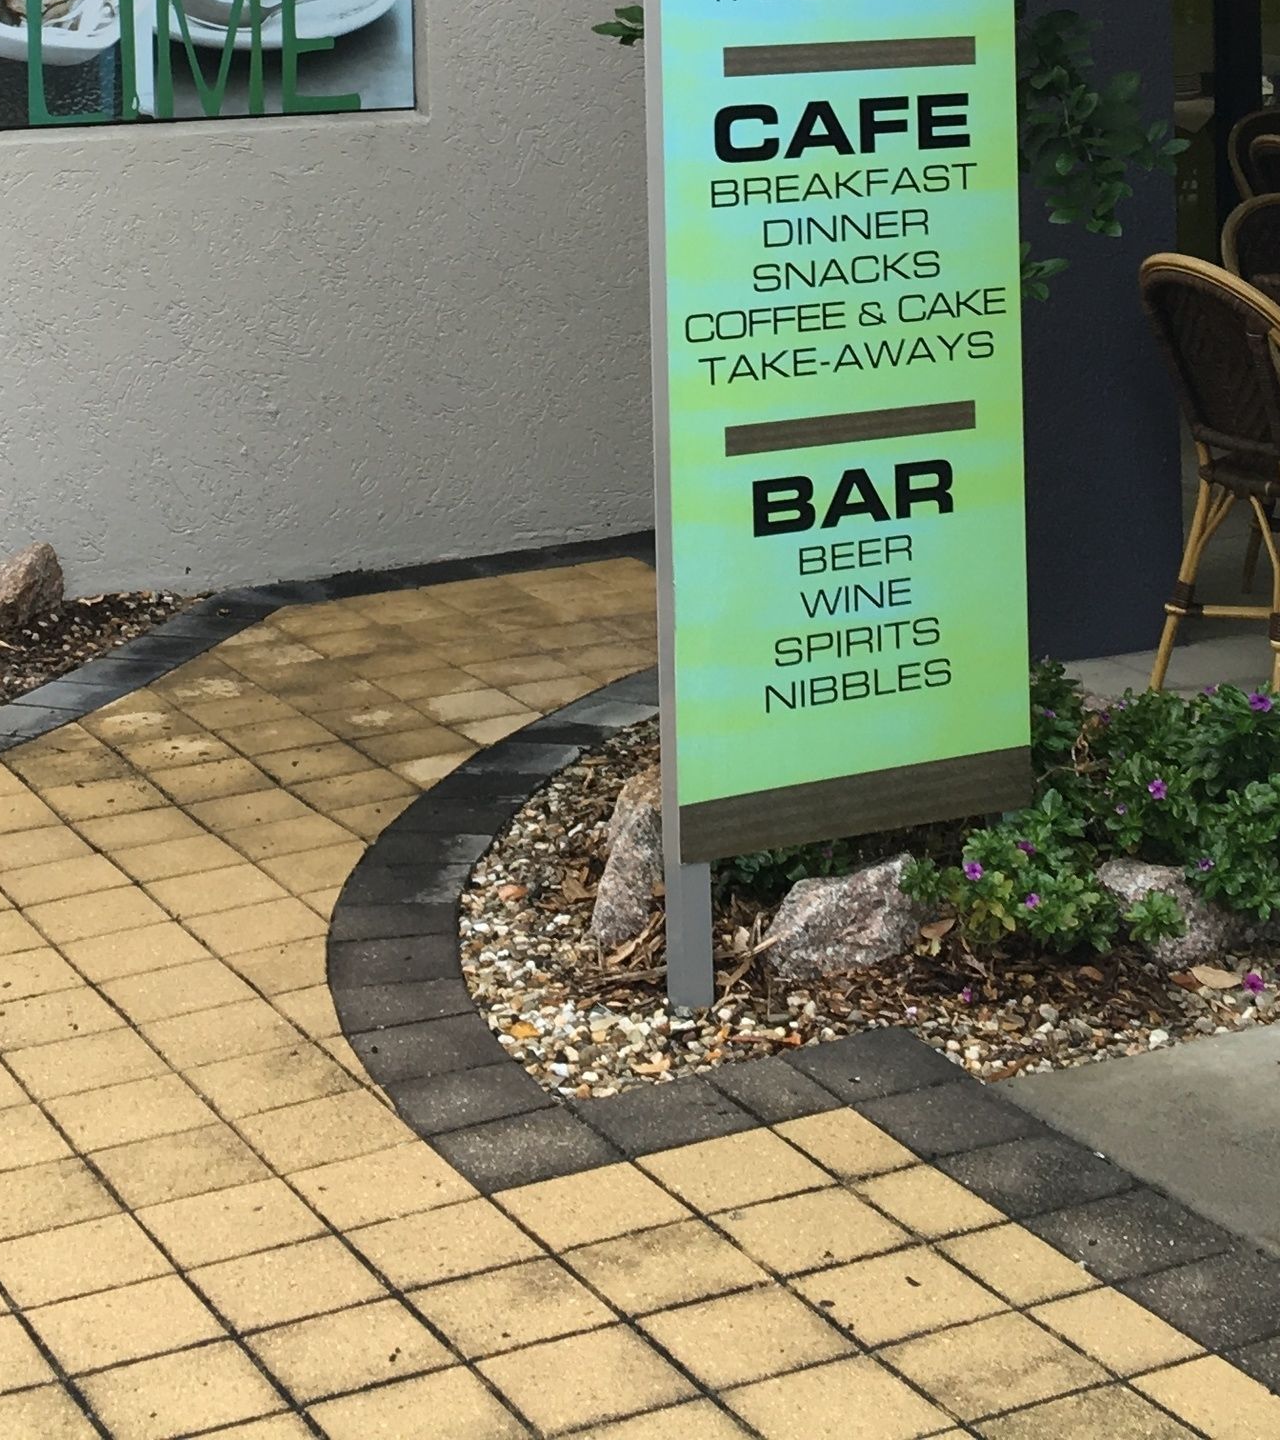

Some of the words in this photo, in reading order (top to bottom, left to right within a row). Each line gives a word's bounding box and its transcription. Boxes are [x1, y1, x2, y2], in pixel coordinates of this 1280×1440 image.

[713, 92, 971, 163] CAFE
[710, 163, 978, 209] BREAKFAST
[763, 208, 929, 248] DINNER
[752, 250, 941, 293] SNACKS
[685, 301, 846, 343] COFFEE
[858, 301, 887, 327] &
[897, 287, 1008, 324] CAKE
[698, 330, 995, 386] TAKE-AWAYS
[752, 458, 954, 538] BAR
[798, 534, 913, 576] BEER
[800, 577, 912, 618] WINE
[774, 616, 941, 668] SPIRITS
[765, 658, 953, 714] NIBBLES
